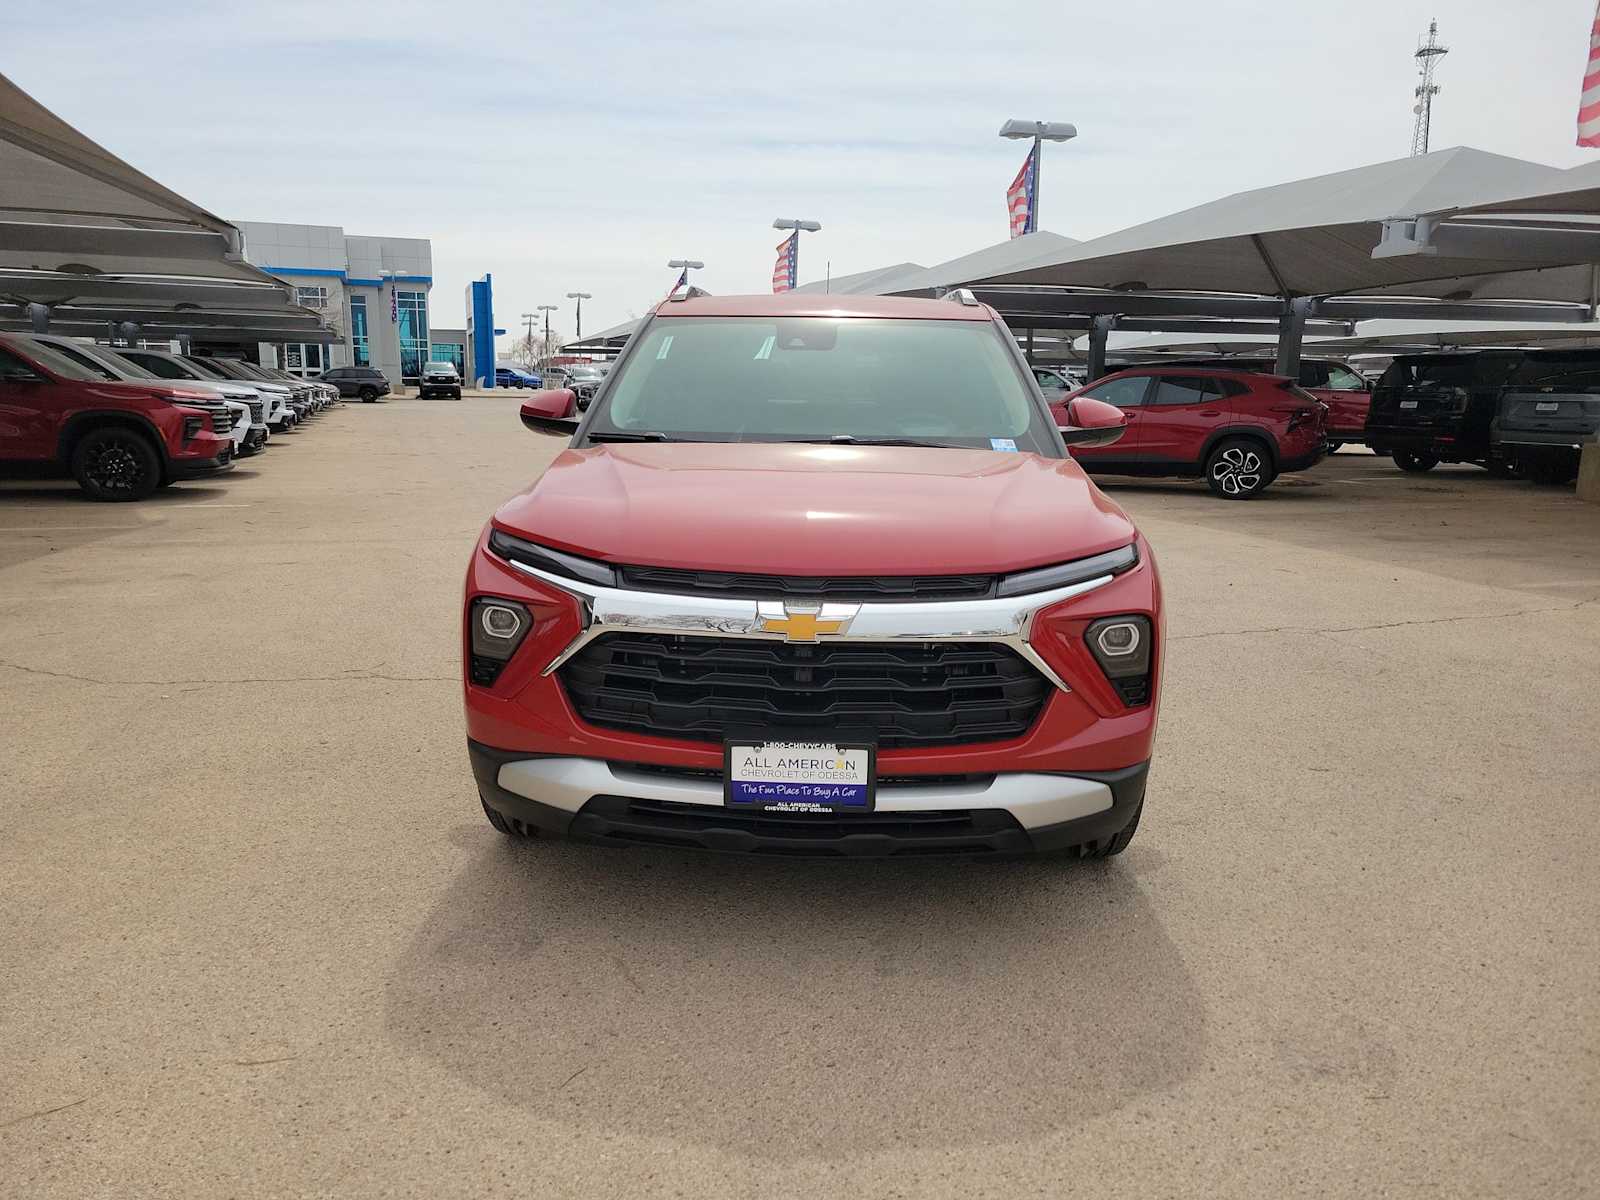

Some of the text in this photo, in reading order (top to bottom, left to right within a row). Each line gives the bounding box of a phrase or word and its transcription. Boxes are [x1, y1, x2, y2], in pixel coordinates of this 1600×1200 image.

[744, 757, 771, 768] ALL
[740, 769, 858, 780] CHEVROLET OF ODESSA
[741, 783, 856, 799] The Fun Place To Buy A Car
